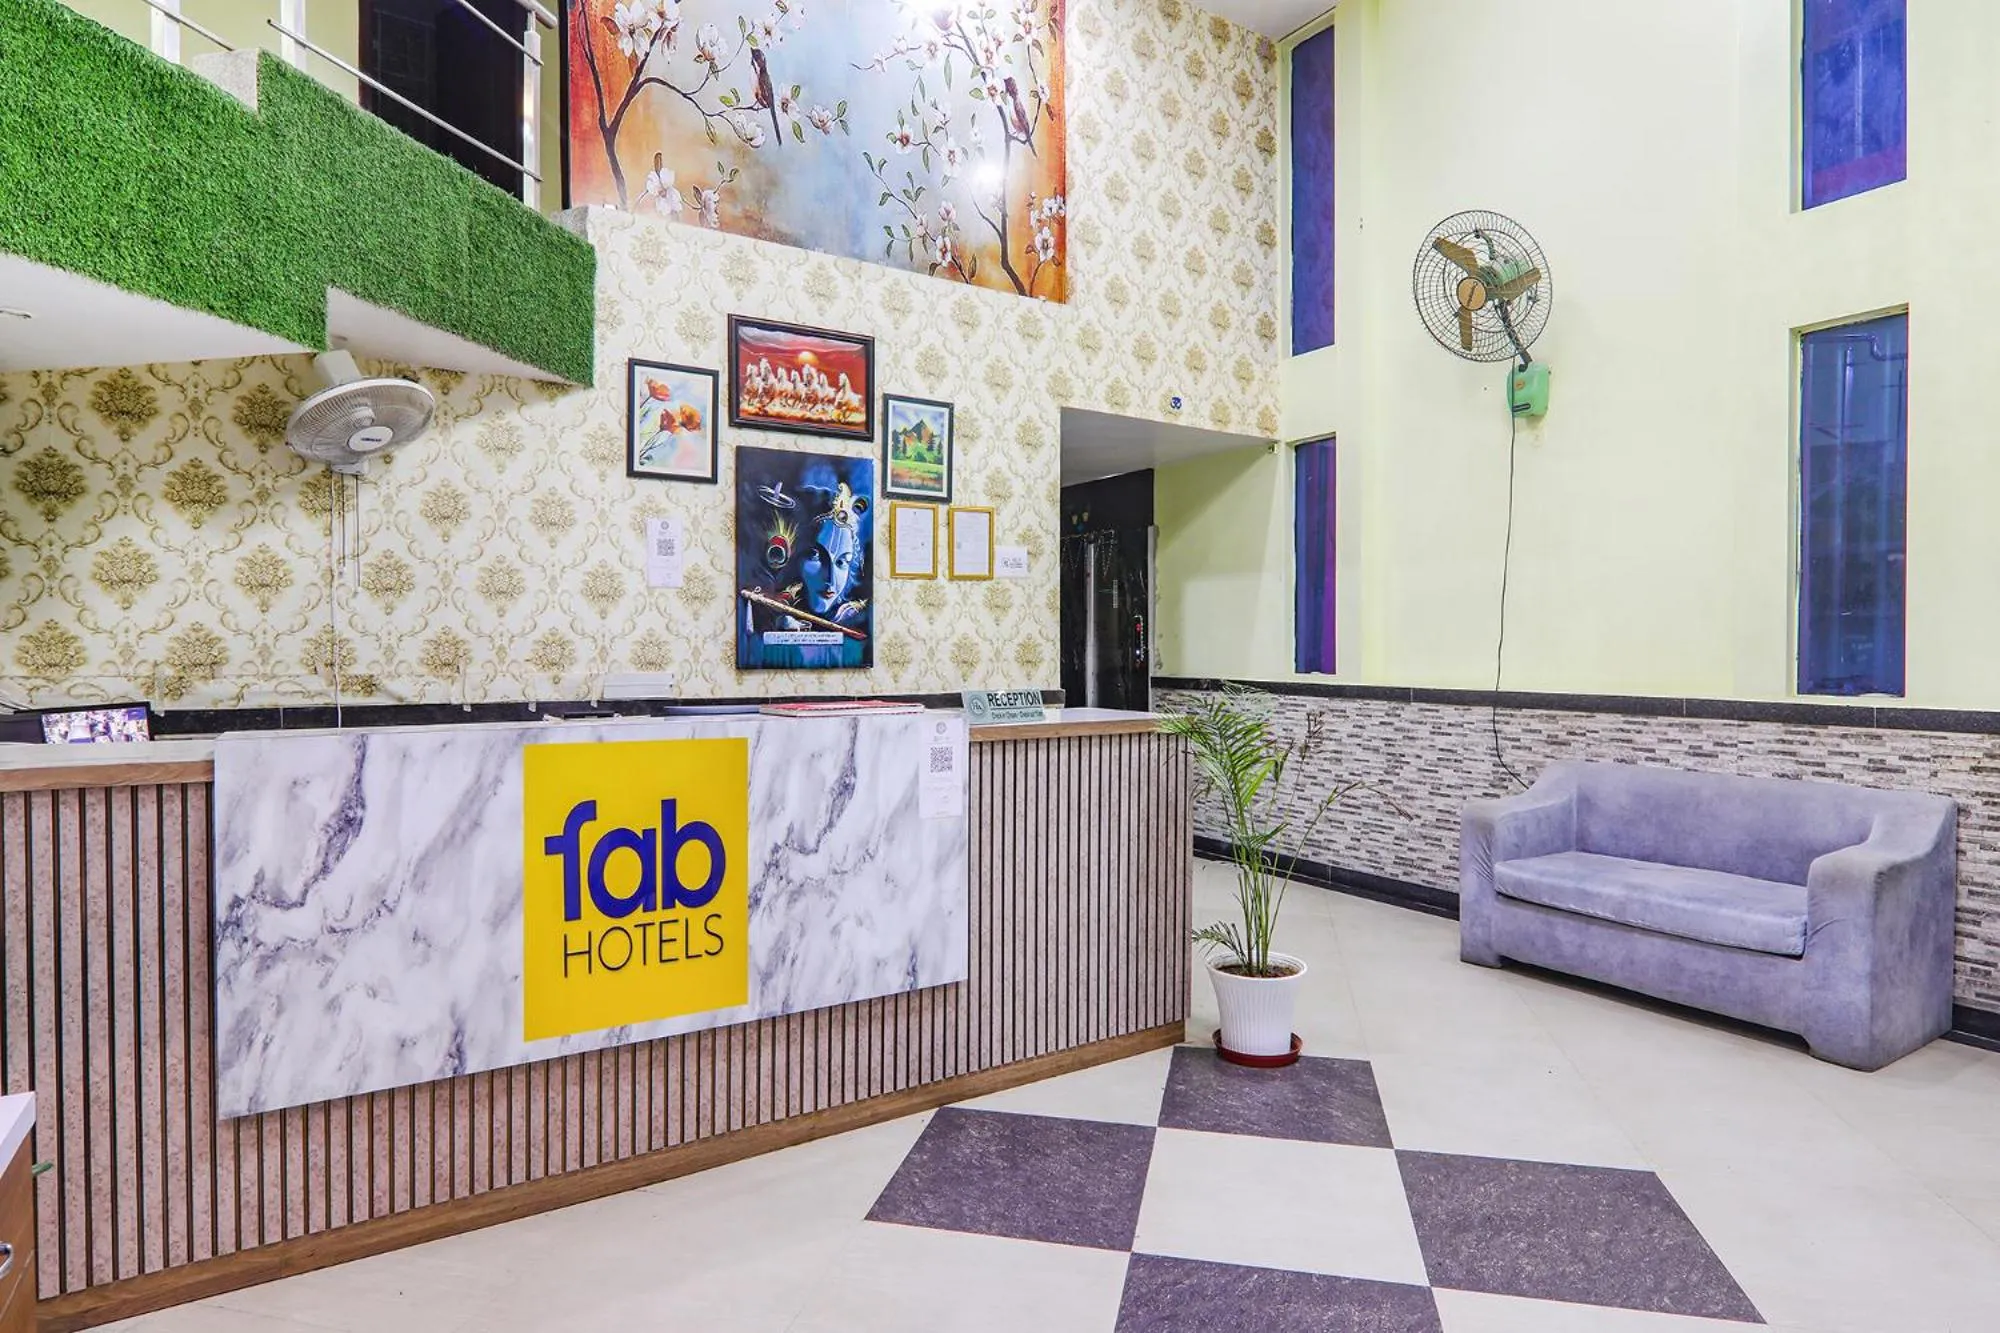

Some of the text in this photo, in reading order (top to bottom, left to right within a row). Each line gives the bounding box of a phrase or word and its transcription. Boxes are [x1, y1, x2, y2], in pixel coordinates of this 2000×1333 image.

[986, 691, 1041, 707] RECEPTION
[544, 798, 726, 921] fab
[564, 913, 724, 978] HOTELS
